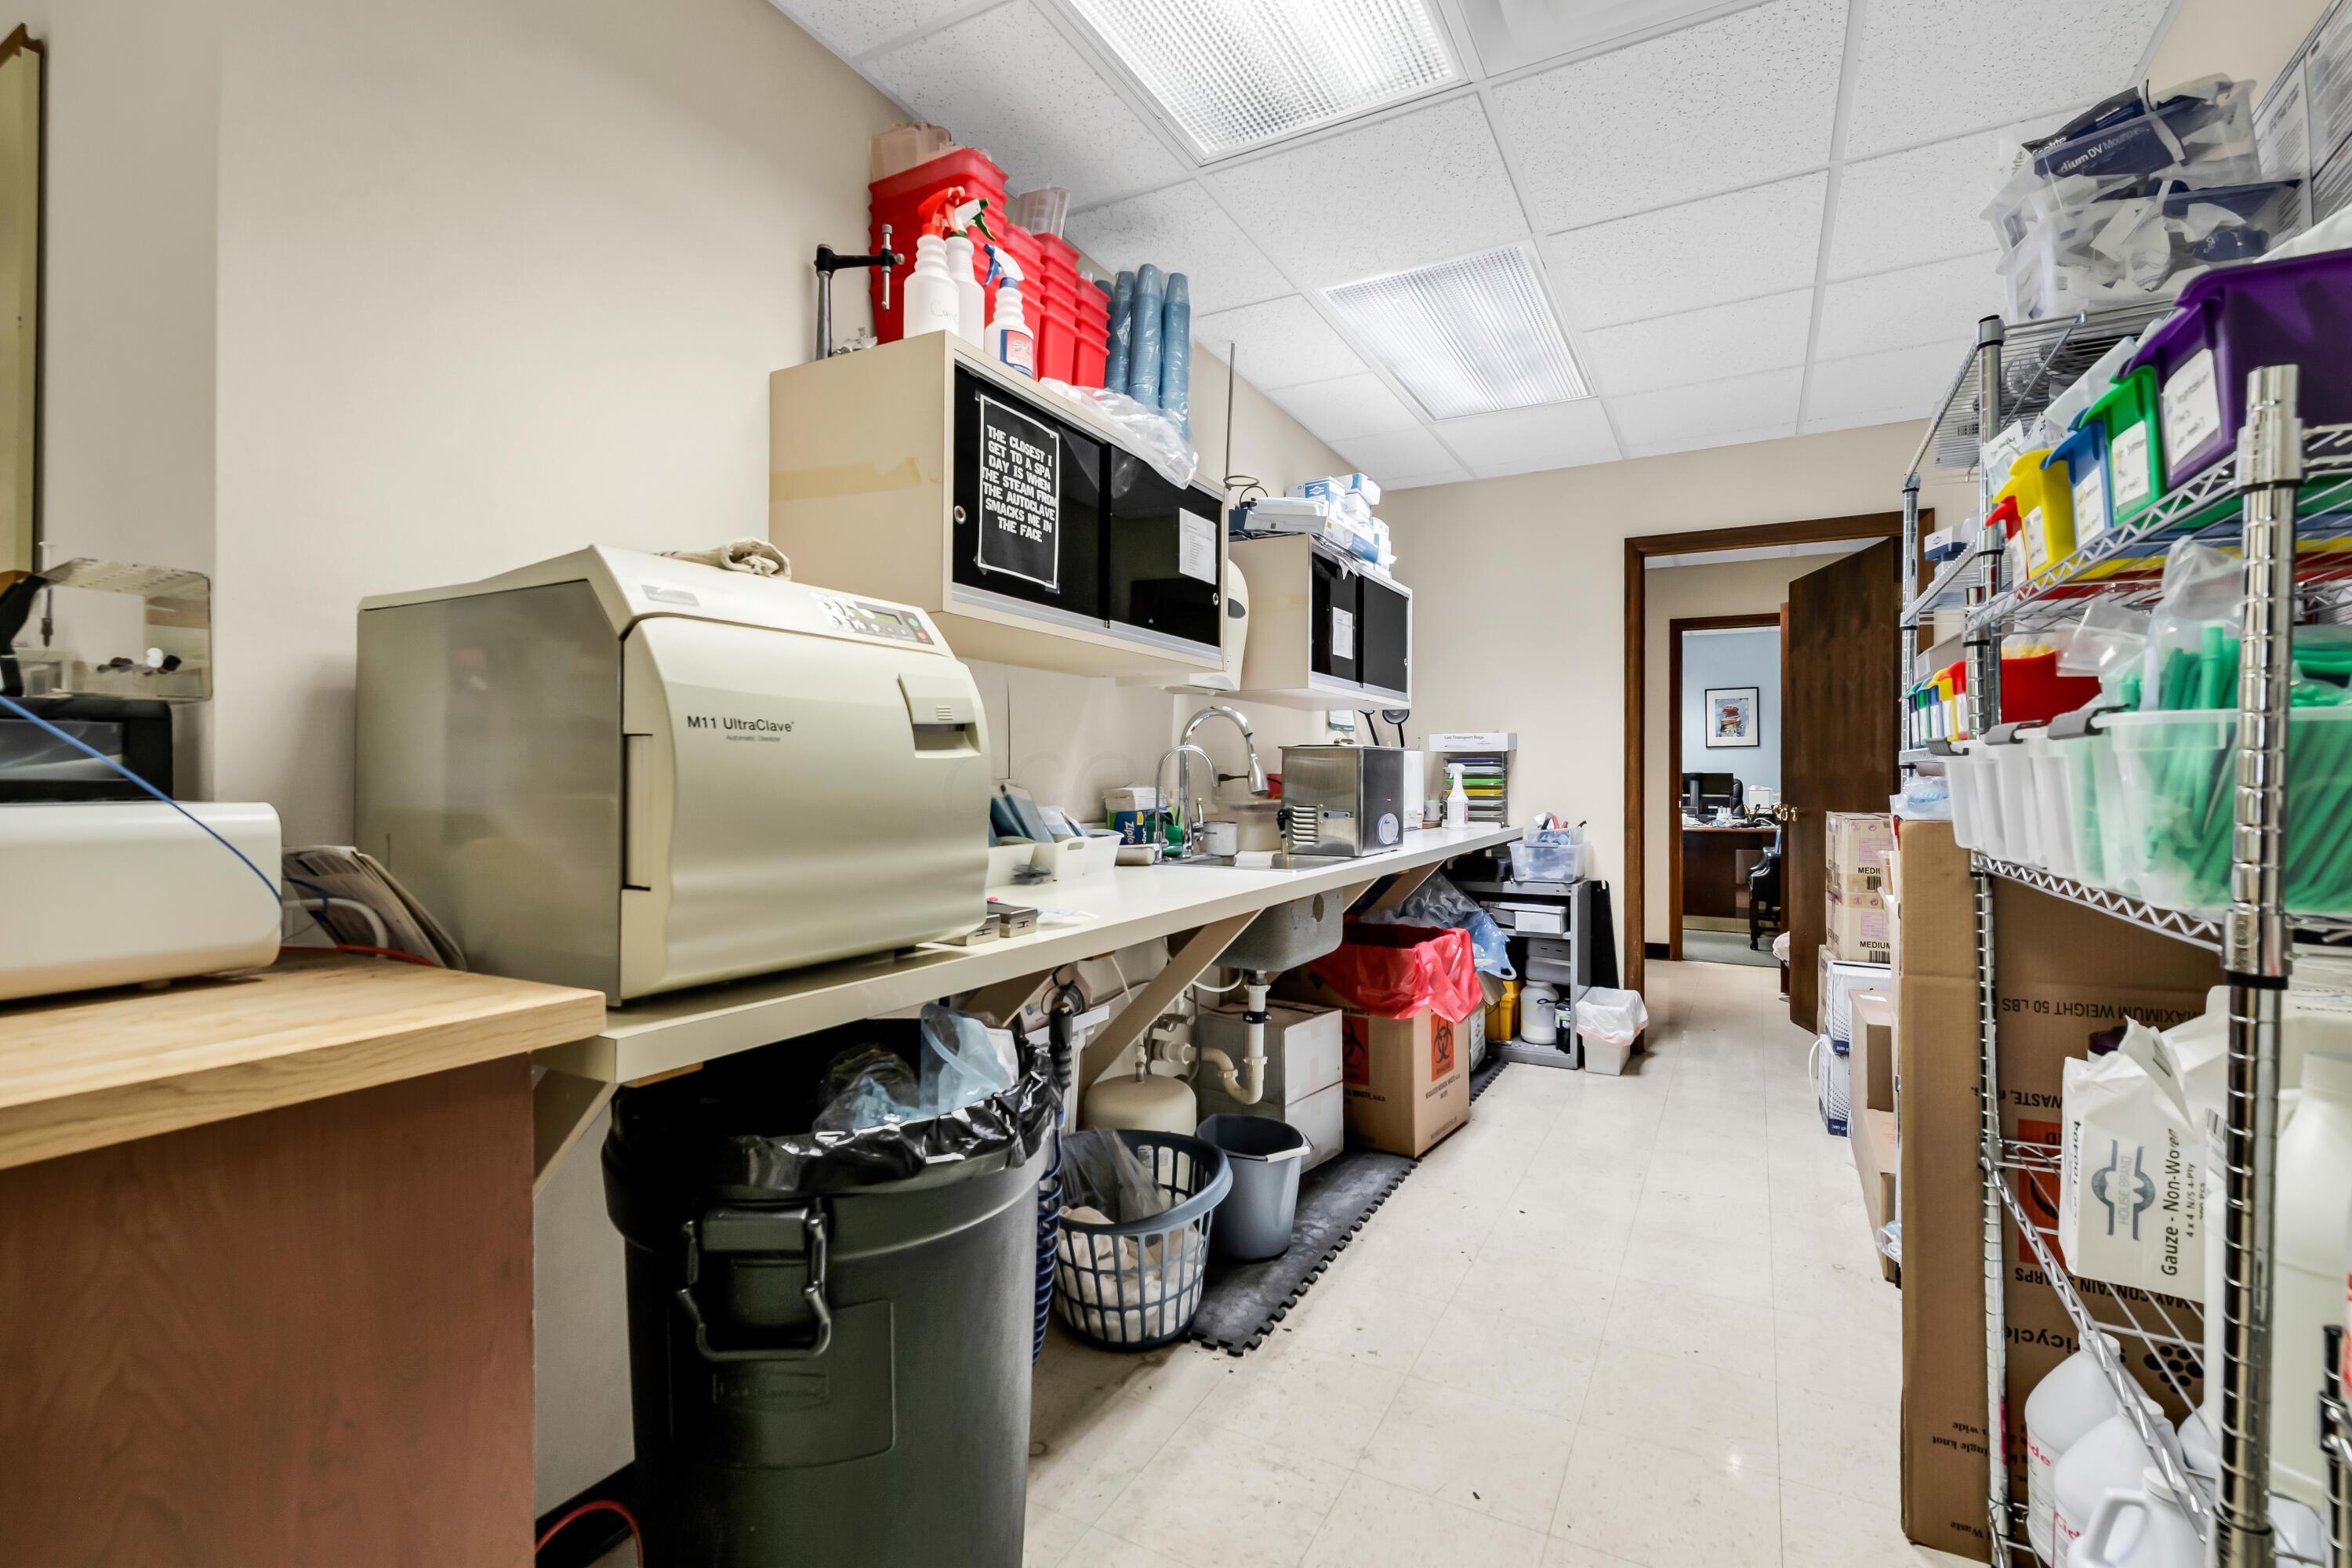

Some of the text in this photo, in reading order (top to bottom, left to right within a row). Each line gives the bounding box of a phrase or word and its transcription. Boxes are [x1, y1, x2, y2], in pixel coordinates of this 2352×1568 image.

[2057, 154, 2089, 174] dium
[2088, 143, 2103, 158] DV
[987, 424, 1052, 467] THE CLOSEST I
[988, 441, 1051, 480] GET TO A SPA
[988, 454, 1051, 492] DAY IS WHEN
[982, 466, 1057, 507] THE STEAM FROM
[983, 481, 1055, 521] THE AUTOCLAVE
[985, 498, 1052, 533] SMACKS ME IN
[997, 516, 1043, 543] THE FACE
[687, 715, 793, 732] M11 UltraClave
[1124, 821, 1135, 845] Ziplo
[2002, 997, 2029, 1013] LBS
[2034, 1000, 2050, 1014] 50
[2053, 1001, 2114, 1019] WEIGHT
[2187, 1163, 2196, 1189] 4-Ply
[2118, 1156, 2132, 1225] HOUSE BRAND
[2187, 1191, 2196, 1210] N/S
[2161, 1226, 2179, 1276] Gauze
[2015, 1267, 2075, 1289] SARPS
[1952, 1421, 1979, 1436] wide
[1932, 1436, 1990, 1457] ingle knot
[1950, 1520, 1984, 1539] Waste
[2055, 1511, 2082, 1541] Cid
